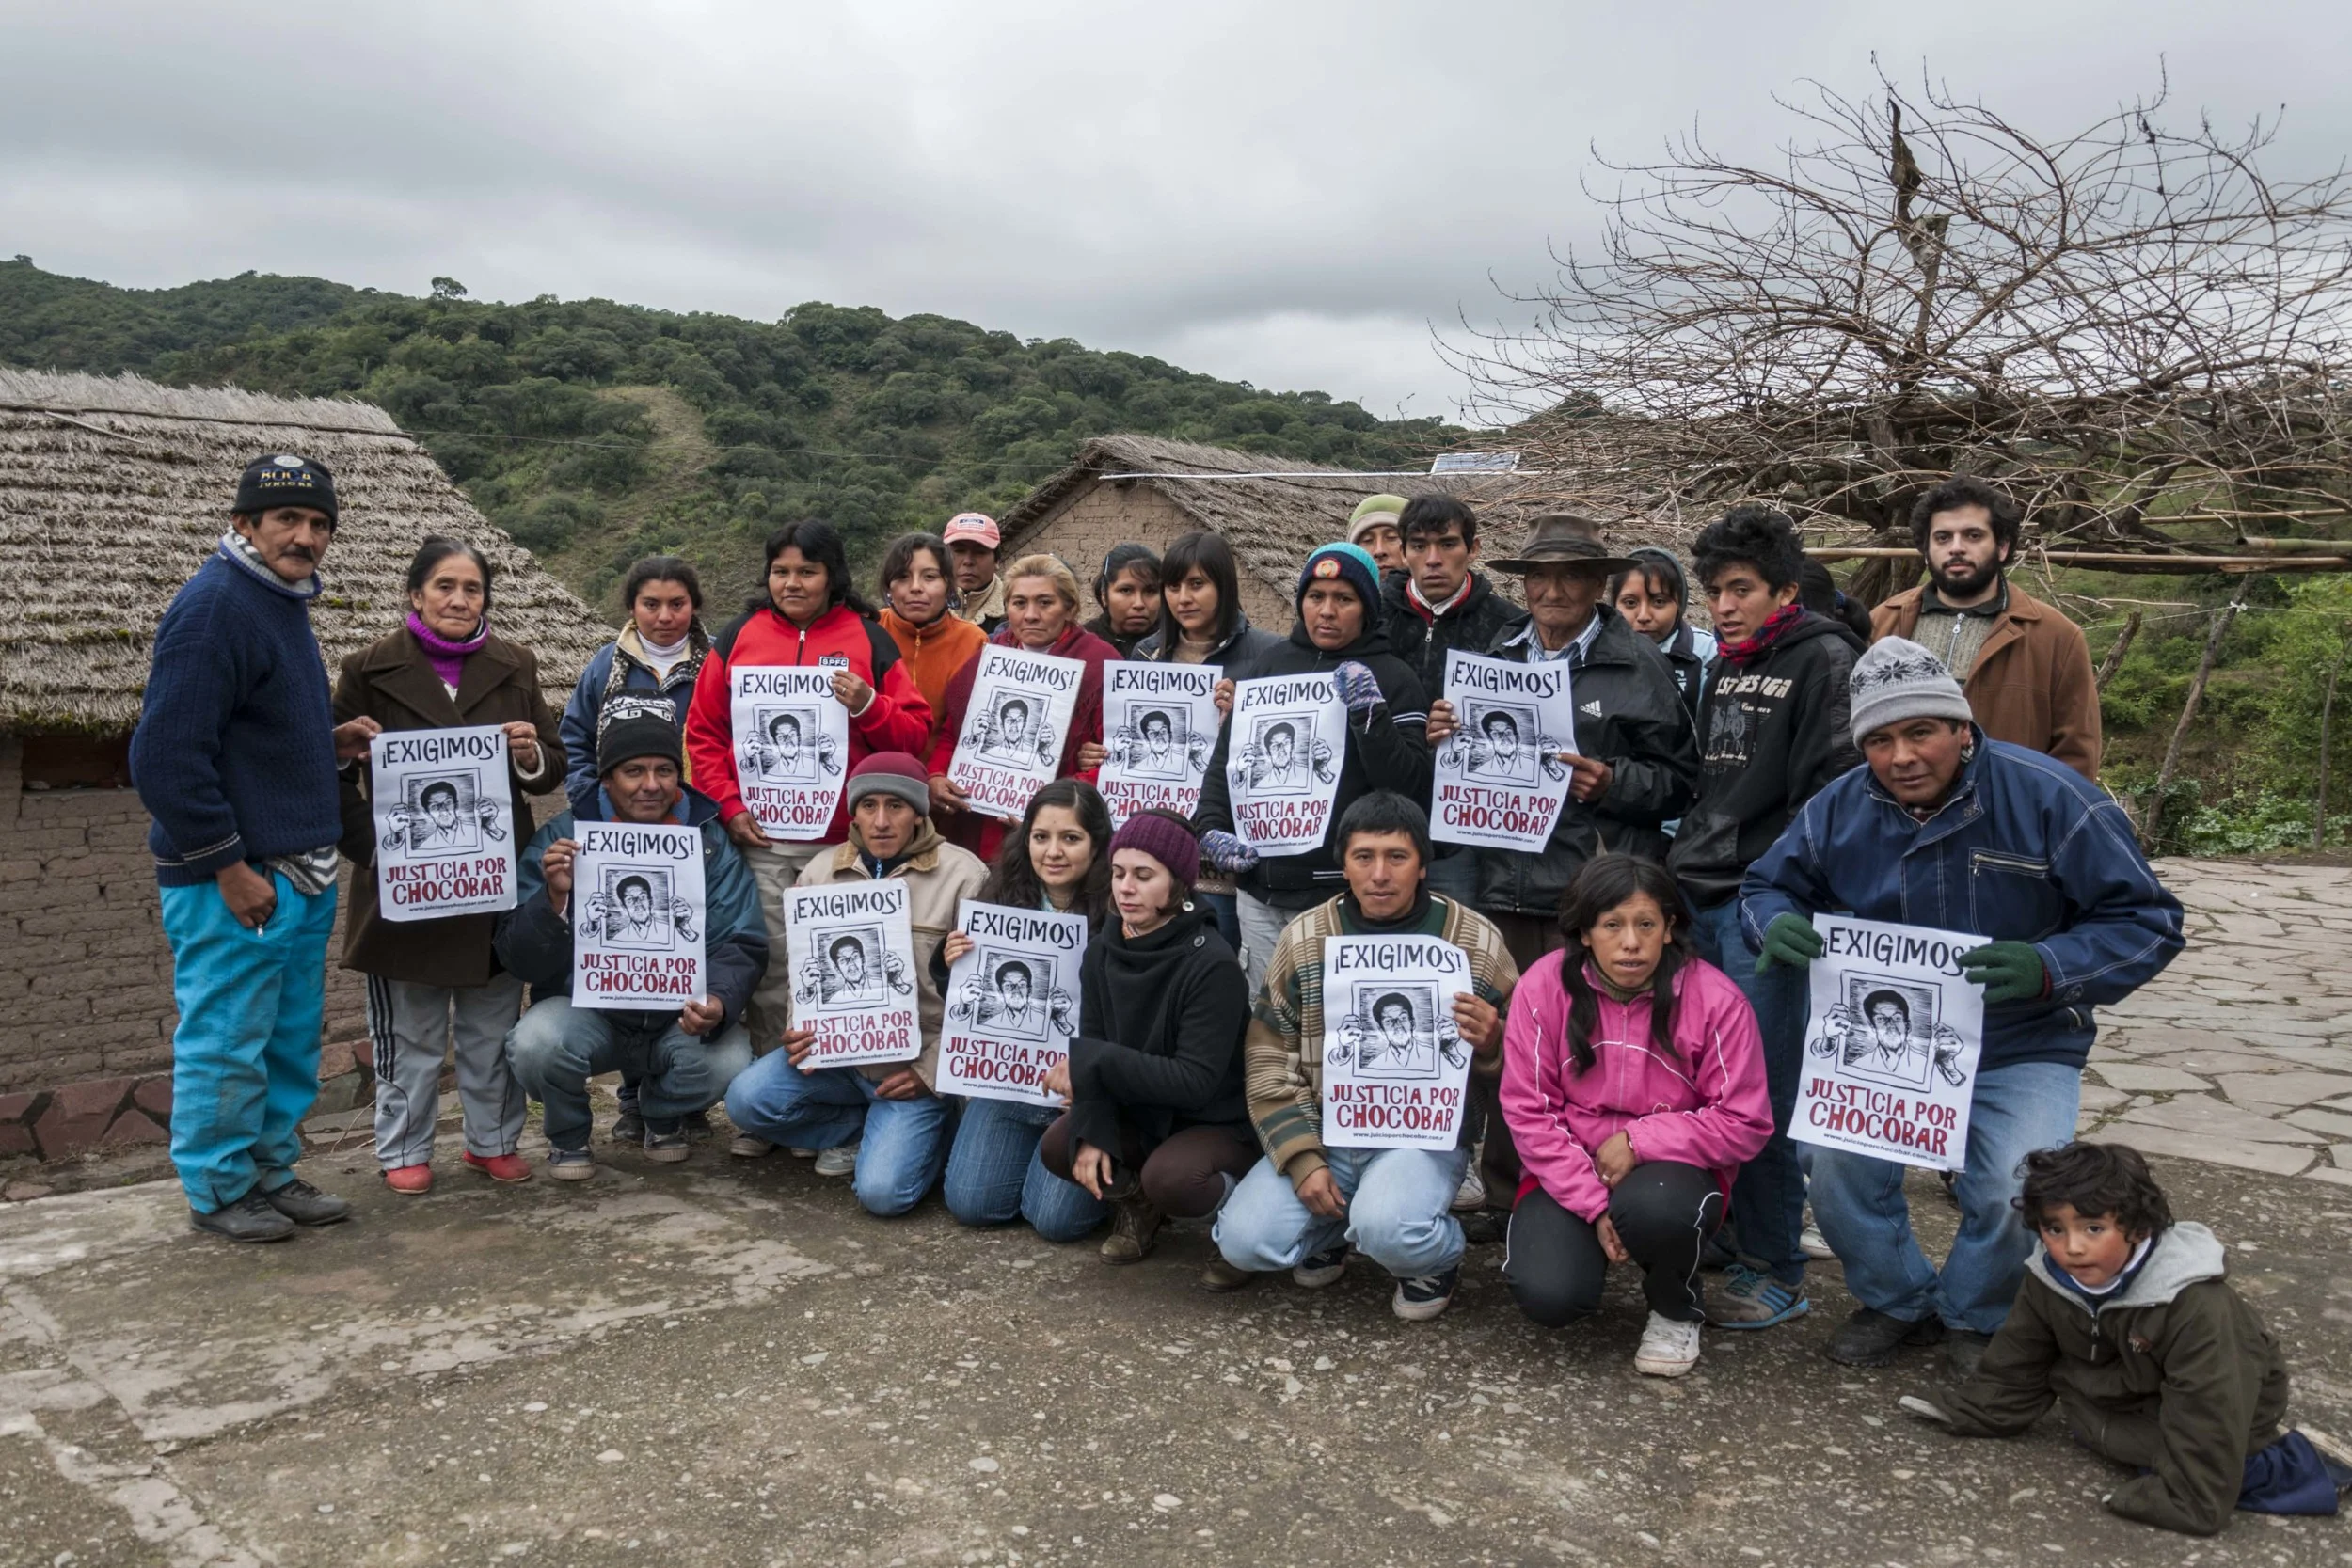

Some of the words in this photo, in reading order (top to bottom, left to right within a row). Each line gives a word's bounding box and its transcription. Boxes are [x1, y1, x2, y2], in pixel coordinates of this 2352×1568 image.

[739, 674, 834, 698] ¡EXIGIMOS
[983, 656, 1078, 691] ¡EXIGIMOS!
[1111, 669, 1215, 697] ¡EXIGIMOS!
[1451, 660, 1561, 698] ¡EXIGIMOS!
[1241, 681, 1335, 712] ¡EXIGIMOS
[382, 734, 500, 768] ¡EXIGIMOS!
[954, 763, 1015, 788] JUSTICIA
[745, 787, 806, 805] JUSTICIA
[813, 790, 835, 806] POR
[1102, 781, 1170, 801] JUSTICIA
[1175, 788, 1200, 802] POR
[1438, 784, 1521, 811] JUSTICIA
[1529, 796, 1557, 816] POR
[751, 803, 828, 825] CHOCOBAR
[1236, 800, 1295, 821] JUSTICIA
[1301, 800, 1328, 817] POR
[1443, 803, 1549, 836] CHOCOBAR
[1243, 816, 1322, 841] CHOCOBAR
[582, 831, 694, 860] ¡EXIGIMOS!
[385, 862, 469, 884] JUSTICIA
[475, 857, 507, 876] POR
[392, 874, 504, 905] CHOCOBAR
[793, 889, 903, 924] ¡EXIGIMOS!
[965, 910, 1081, 950] ¡EXIGIMOS!
[580, 954, 659, 973] JUSTICIA
[666, 958, 697, 974] POR
[1334, 944, 1461, 974] ¡EXIGIMOS!
[1821, 927, 1968, 976] ¡EXIGIMOS
[585, 971, 692, 995] CHOCOBAR
[882, 1010, 913, 1028] POR
[946, 1037, 1028, 1063] JUSTICIA
[949, 1055, 1048, 1087] CHOCOBA
[1329, 1084, 1422, 1105] JUSTICIA
[1430, 1086, 1460, 1107] POR
[1806, 1077, 1906, 1118] JUSTICIA
[1914, 1101, 1957, 1130] POR
[1336, 1104, 1454, 1132] CHOCOBAR
[1808, 1101, 1947, 1156] CHOCOBAR
